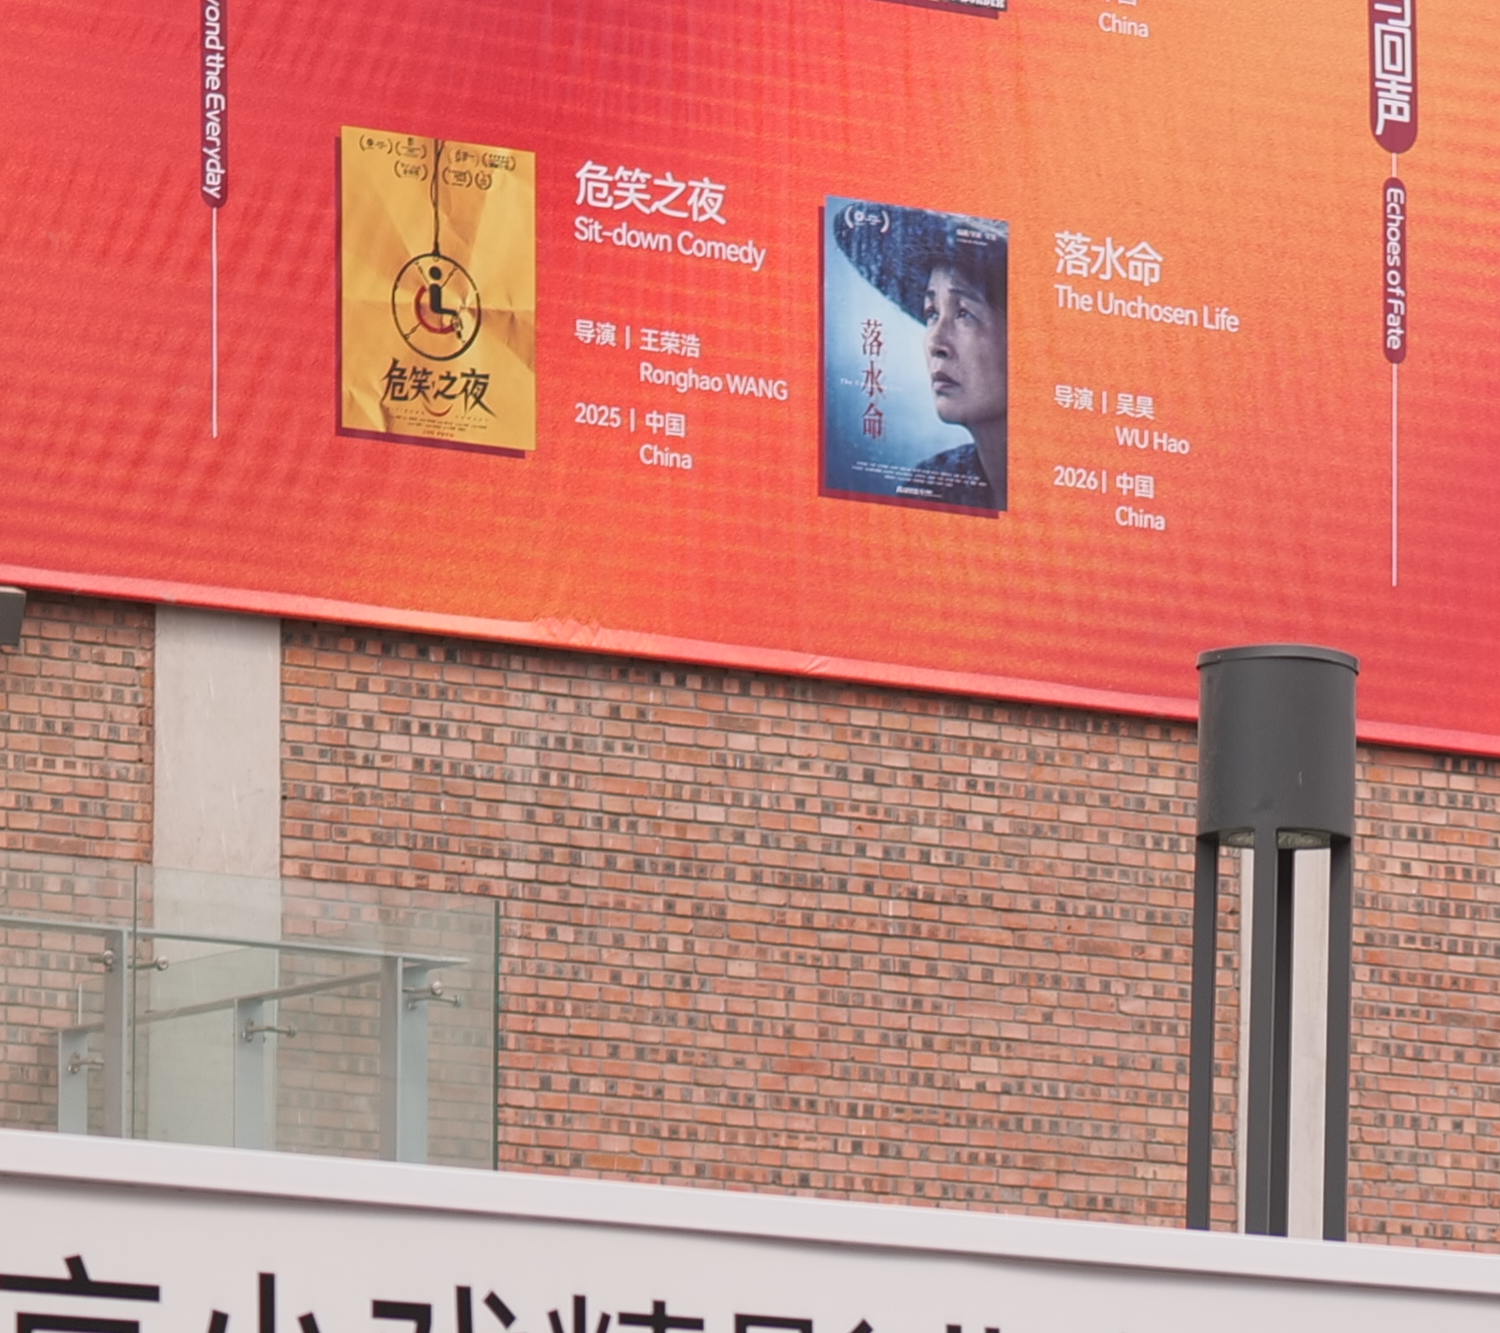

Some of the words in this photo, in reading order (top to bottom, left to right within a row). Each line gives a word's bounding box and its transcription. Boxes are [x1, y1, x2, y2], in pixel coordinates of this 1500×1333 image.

[1098, 12, 1149, 38] China
[204, 53, 225, 89] the
[202, 93, 226, 199] Everyday
[575, 160, 726, 226] 危笑之夜
[574, 216, 672, 254] Sit-down
[677, 231, 766, 272] Comedy
[1386, 187, 1405, 267] Echoes
[1053, 231, 1164, 287] 落水命
[1387, 269, 1406, 298] of
[1053, 285, 1093, 315] The
[1096, 291, 1199, 327] Unchosen
[1202, 301, 1240, 333] Life
[1386, 298, 1405, 350] Fate
[575, 320, 617, 348] 导演
[640, 328, 702, 359] 王荣浩
[381, 358, 496, 417] 危笑之夜
[639, 362, 722, 396] Ronghao
[726, 372, 789, 401] WANG
[861, 319, 884, 440] 落水命
[1053, 385, 1094, 412] 导演
[575, 403, 622, 429] 2025
[645, 412, 687, 438] 中国
[639, 443, 693, 471] China
[1115, 426, 1149, 450] WU
[1153, 431, 1191, 457] Hao
[1053, 466, 1099, 492] 2026
[1115, 473, 1155, 499] 中国
[1115, 505, 1166, 532] China
